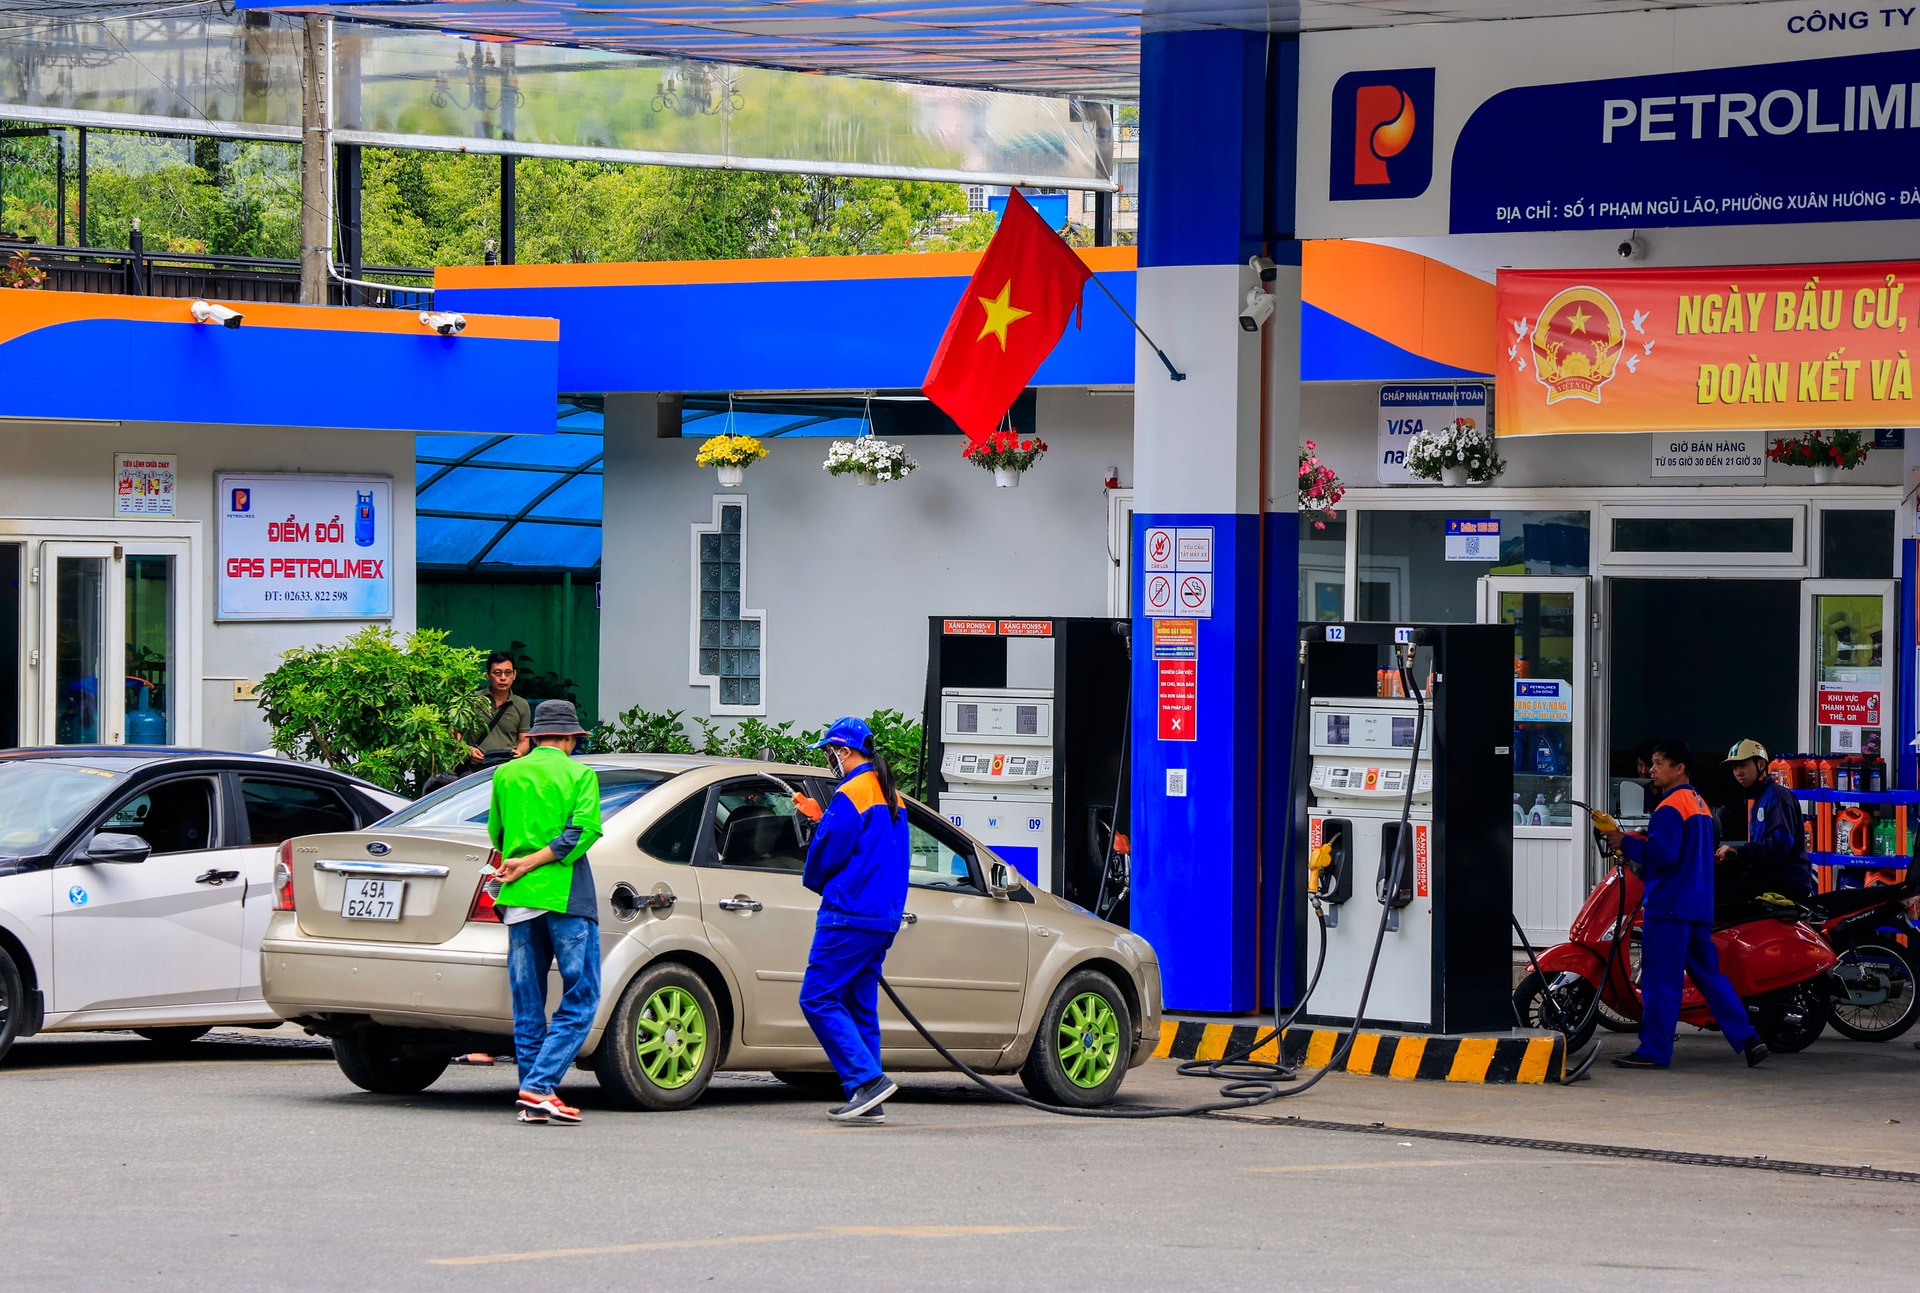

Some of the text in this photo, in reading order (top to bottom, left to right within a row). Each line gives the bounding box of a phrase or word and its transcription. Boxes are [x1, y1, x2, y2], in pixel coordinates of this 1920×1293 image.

[1787, 7, 1916, 34] CÔNG TY
[1496, 206, 1521, 223] ĐỊA
[1563, 197, 1584, 218] SỐ
[1588, 203, 1595, 217] 1
[1599, 202, 1643, 219] PHẠM
[1647, 196, 1680, 215] NGŨ
[1683, 196, 1719, 214] LÃO,
[1722, 193, 1783, 212] PHƯỜNG
[1787, 192, 1828, 209] XUÂN
[1832, 190, 1886, 207] HƯƠNG
[1676, 273, 1908, 335] NGÀY BẦU CỬ,
[1696, 346, 1914, 404] ĐOÀN KẾT VÀ
[1382, 389, 1484, 402] CHẤP NHẬN THANH TOÁN
[1385, 419, 1424, 435] VISA
[1670, 440, 1746, 452] GIỜ BÁN HÀNG
[1655, 454, 1762, 466] TỪ 05 GIỜ 30 ĐẾN 21 GIỜ 30
[268, 514, 344, 543] ĐIỂM ĐỔI
[226, 558, 384, 579] GAS PETROLIMEX
[264, 591, 348, 601] ĐT: 02633. 822 598
[1329, 629, 1342, 639] 12
[1399, 630, 1410, 640] 11
[1844, 694, 1859, 703] VỰC
[1846, 703, 1866, 711] TOÁN
[950, 816, 961, 826] 10
[1029, 819, 1040, 829] 09
[370, 844, 384, 852] Ford
[361, 882, 384, 898] 49A
[348, 900, 394, 918] 624.77
